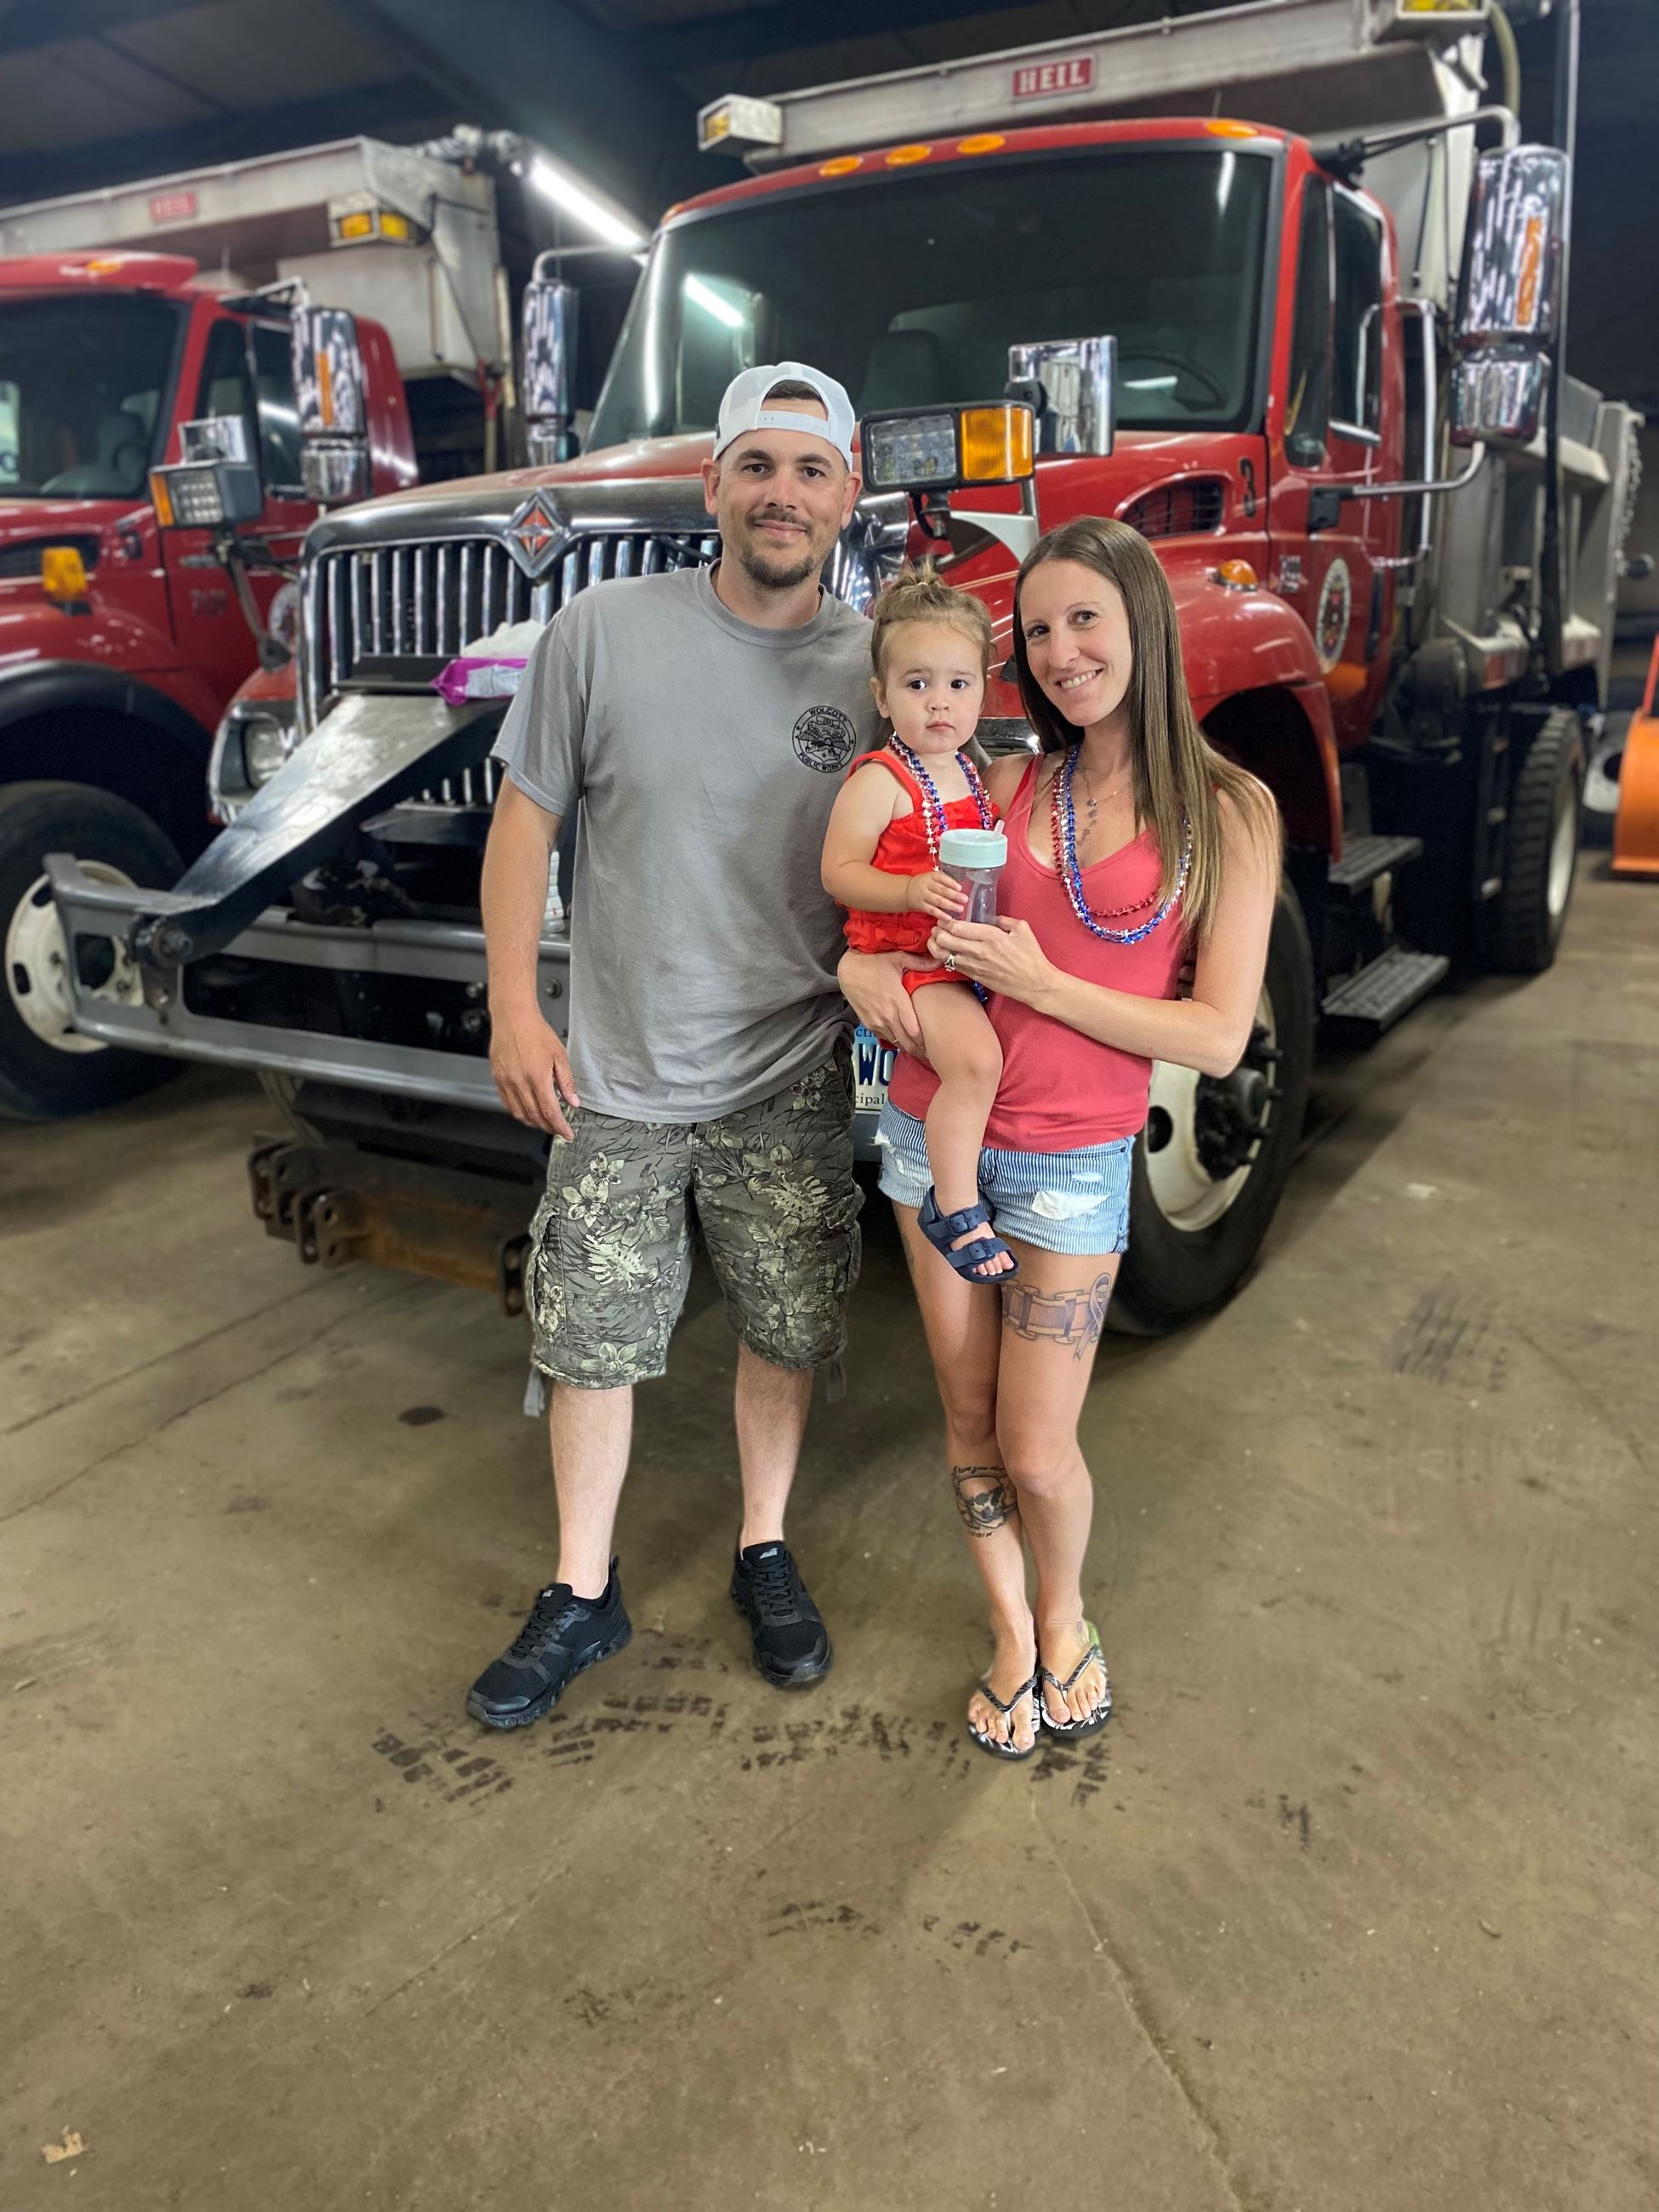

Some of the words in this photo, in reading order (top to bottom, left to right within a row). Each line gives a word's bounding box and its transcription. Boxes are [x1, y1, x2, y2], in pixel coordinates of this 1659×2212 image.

[1018, 61, 1086, 94] HEIL
[808, 707, 847, 722] WOLCOTT
[799, 751, 822, 770] PUBLIC
[821, 761, 844, 772] WORKS
